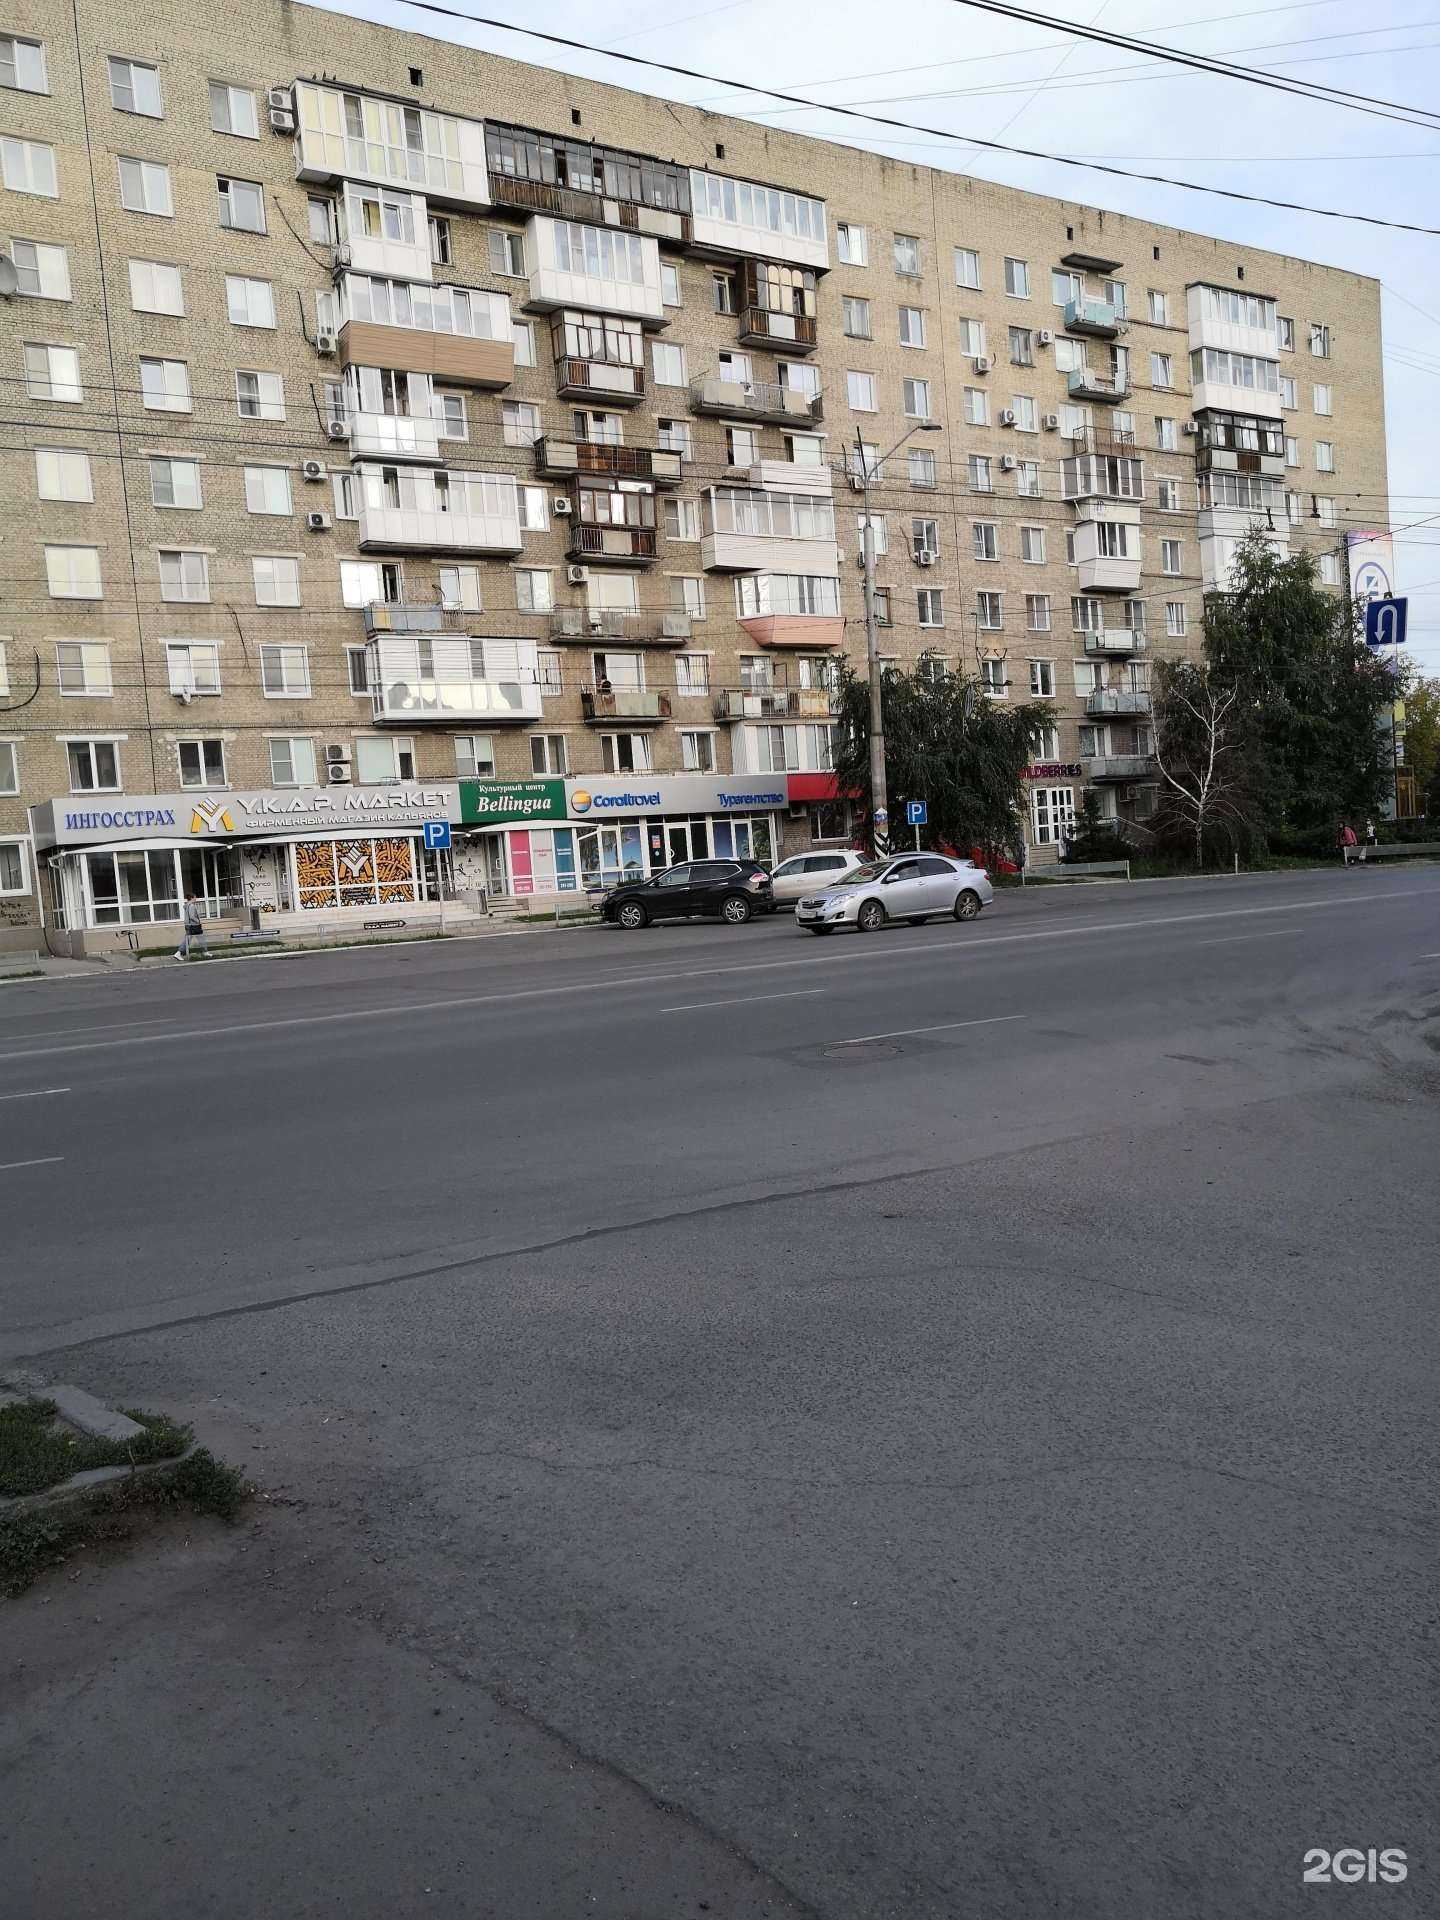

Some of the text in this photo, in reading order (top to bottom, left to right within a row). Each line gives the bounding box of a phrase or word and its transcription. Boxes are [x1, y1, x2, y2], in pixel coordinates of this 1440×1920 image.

[478, 784, 546, 793] Культурный центр
[344, 792, 451, 811] MARKET
[477, 796, 552, 814] Bellingua
[717, 793, 784, 808] Турагентство
[66, 809, 176, 830] ИНГОССТРАХ
[245, 811, 449, 828] ФИРМЕННЫЙ МАГАЗИН КАЛЬЯНОВ
